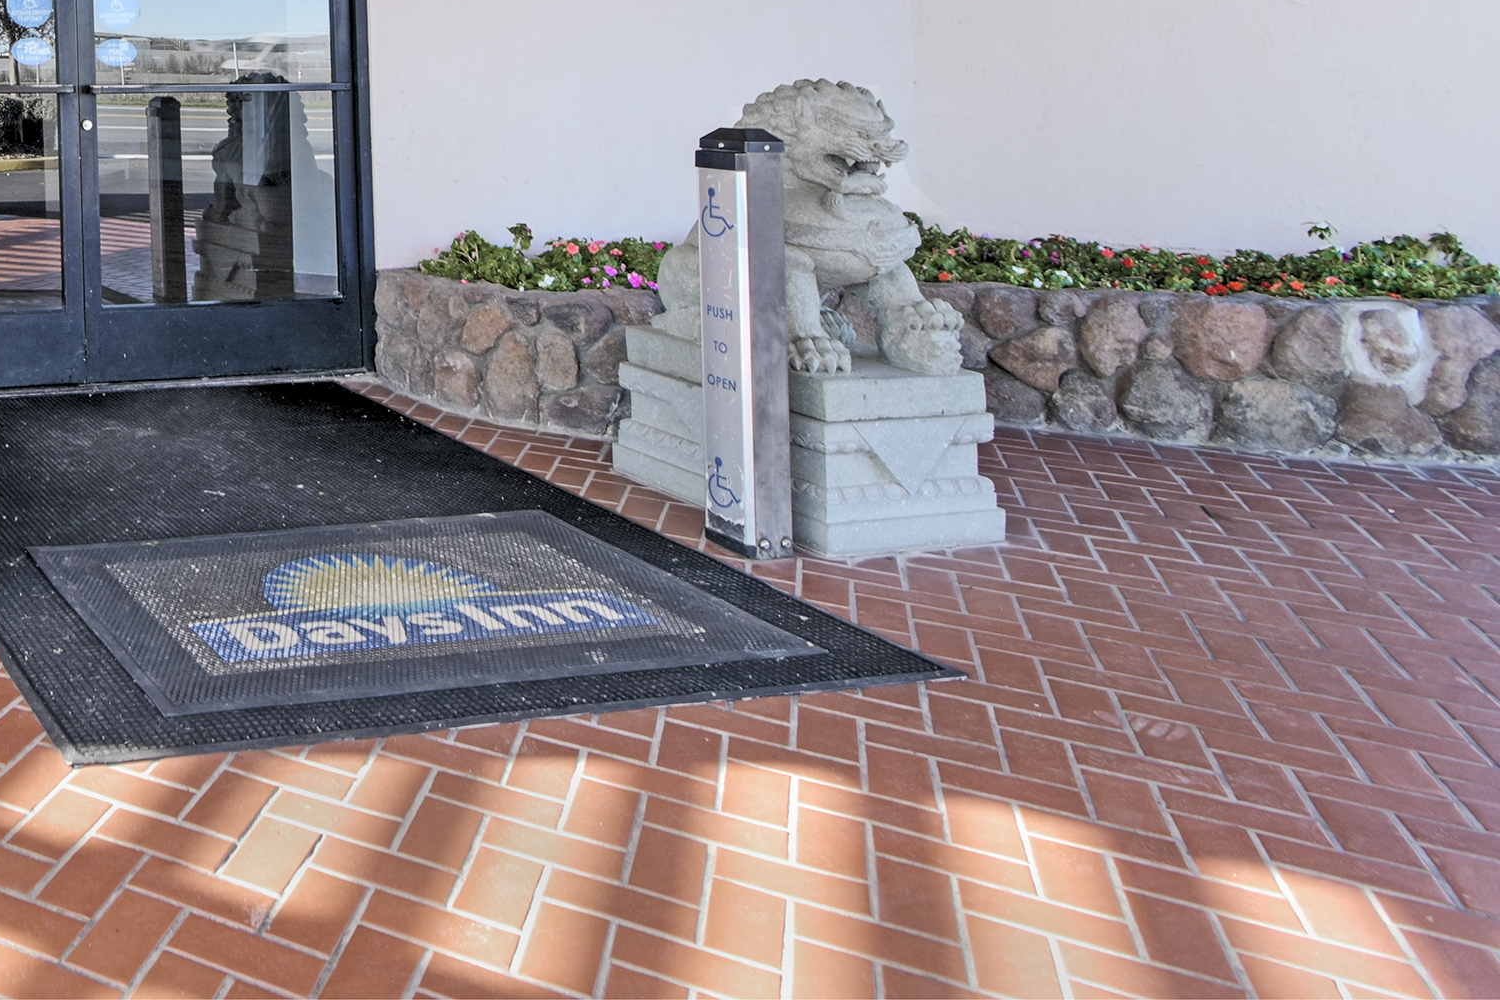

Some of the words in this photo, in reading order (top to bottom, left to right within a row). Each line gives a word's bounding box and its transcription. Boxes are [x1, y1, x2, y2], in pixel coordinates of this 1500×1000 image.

[707, 304, 733, 320] PUSH
[713, 340, 727, 354] TO
[707, 373, 736, 392] OPEN
[225, 611, 464, 653] Days
[457, 598, 629, 631] Inn
